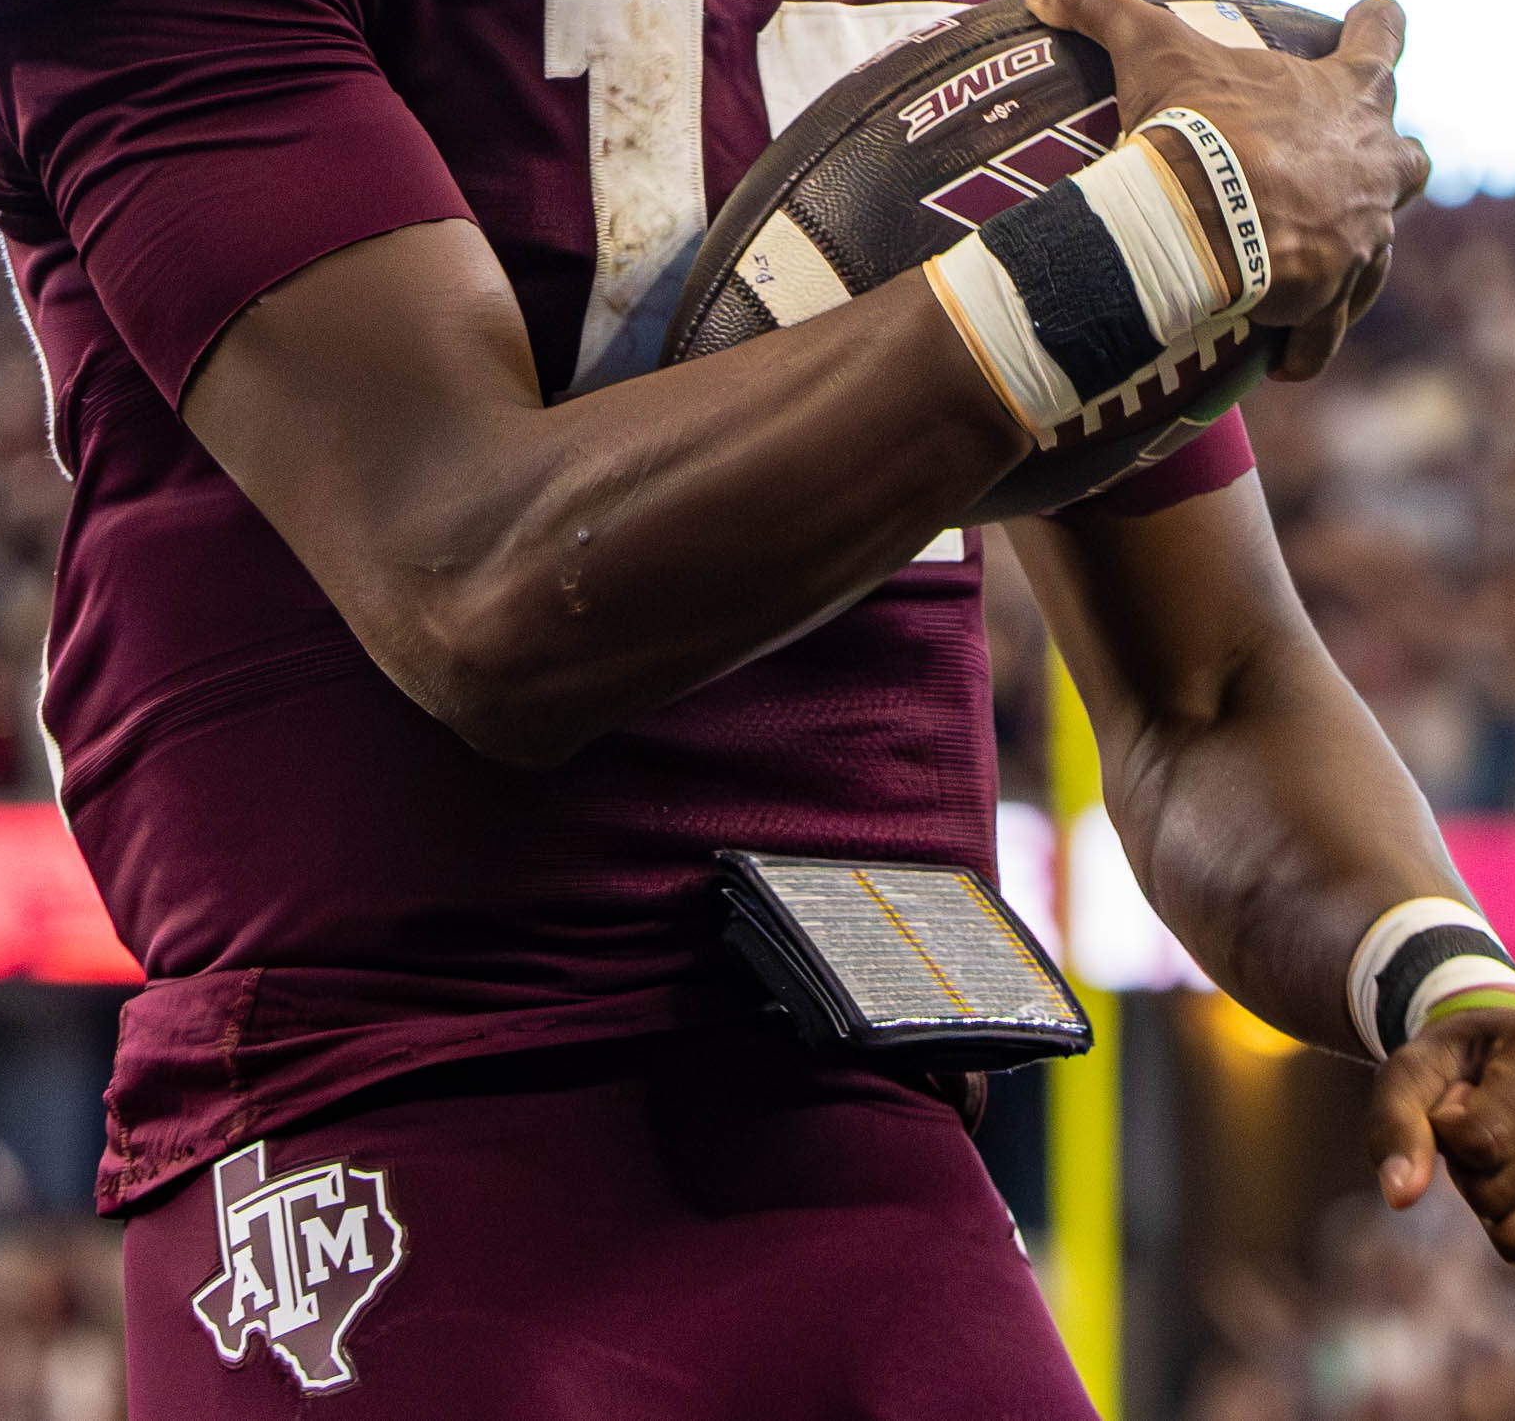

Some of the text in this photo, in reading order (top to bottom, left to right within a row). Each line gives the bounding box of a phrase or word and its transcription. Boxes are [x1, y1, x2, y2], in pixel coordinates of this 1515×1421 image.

[898, 37, 1055, 142] DIME
[1187, 119, 1265, 288] BETTER BEST
